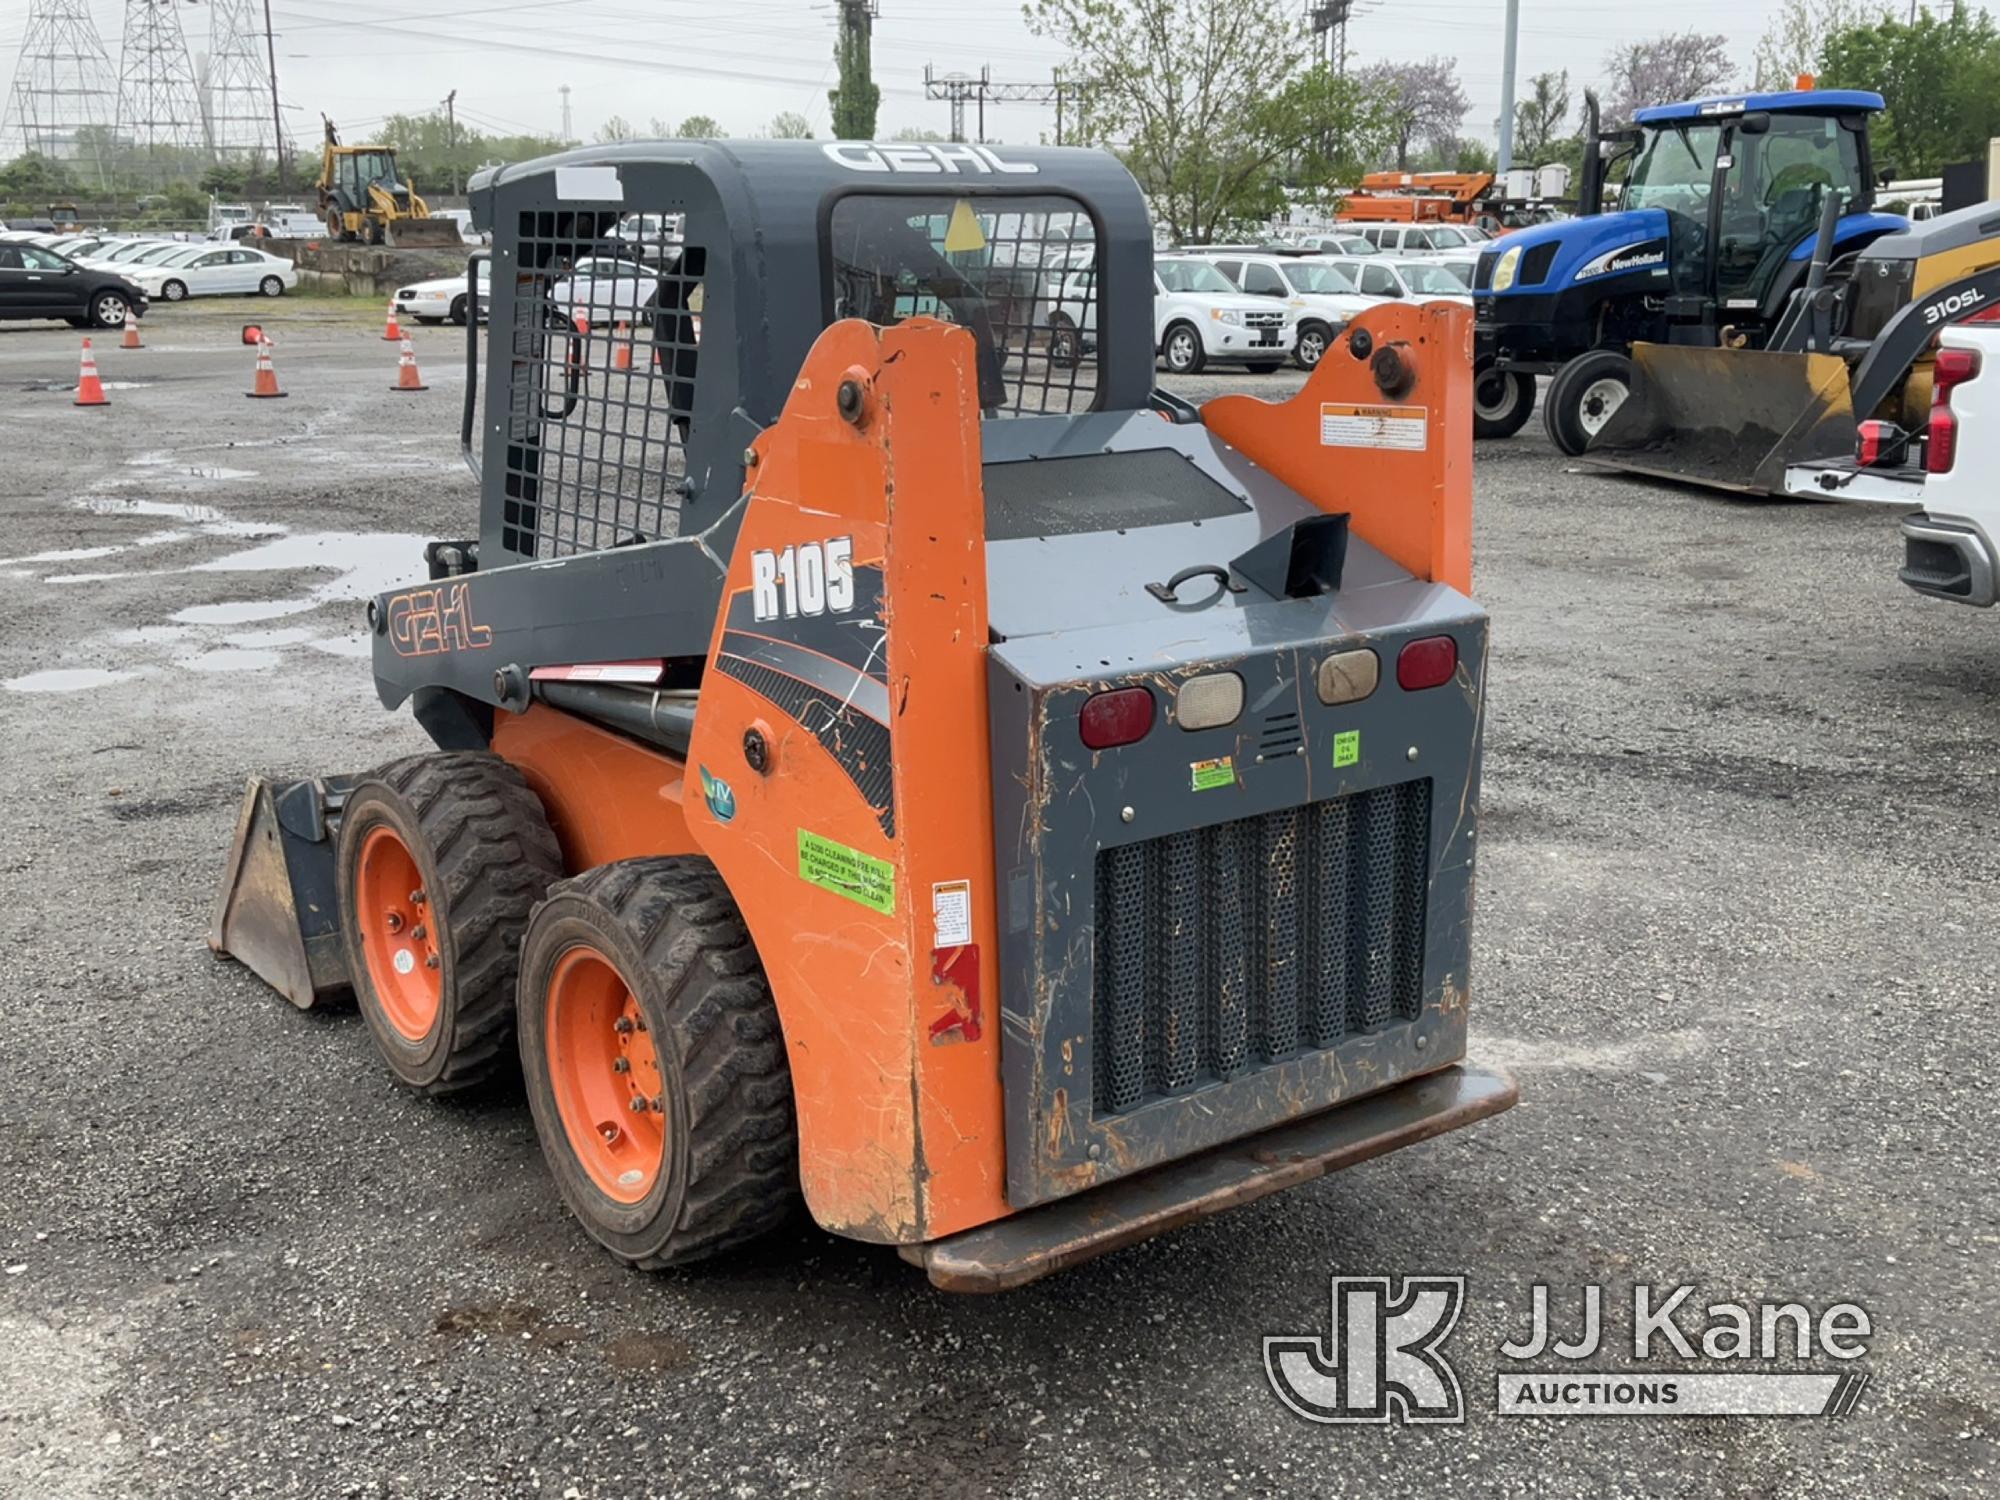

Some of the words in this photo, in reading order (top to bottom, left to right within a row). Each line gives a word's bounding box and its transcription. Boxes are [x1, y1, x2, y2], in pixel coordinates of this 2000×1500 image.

[823, 143, 1039, 173] GEHL
[1924, 288, 1985, 324] 310SL
[751, 536, 854, 623] R105
[388, 582, 493, 657] GEHL
